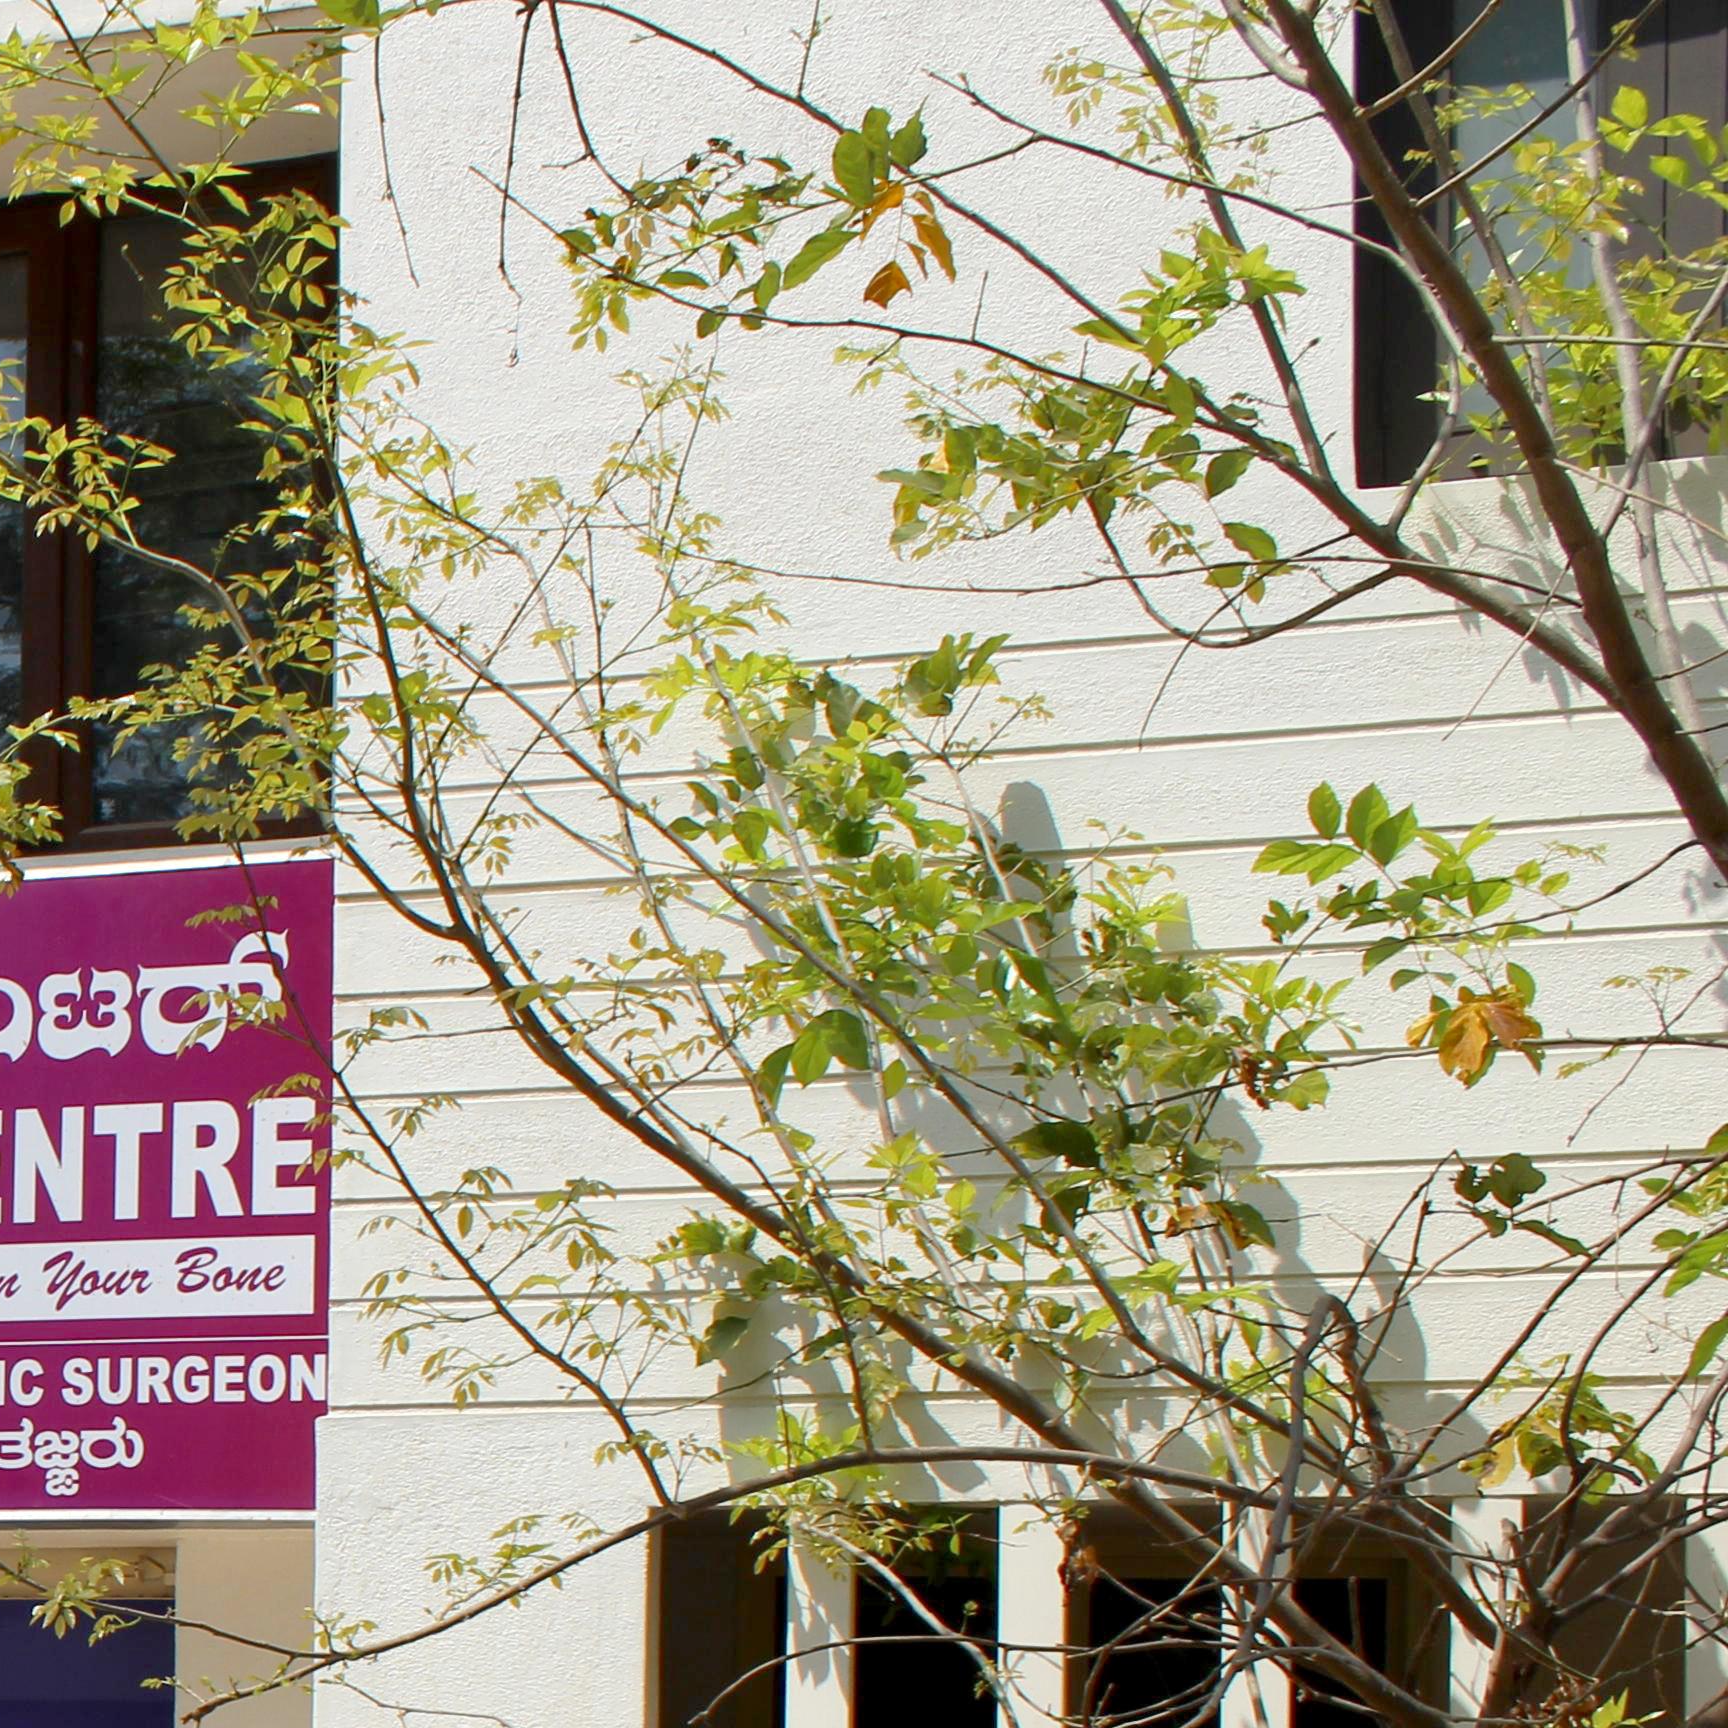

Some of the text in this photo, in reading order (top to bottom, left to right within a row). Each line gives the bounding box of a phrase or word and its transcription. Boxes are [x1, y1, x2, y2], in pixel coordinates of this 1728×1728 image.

[42, 1250, 153, 1312] Your
[175, 1246, 287, 1293] Bone
[60, 1351, 328, 1405] SURGEON
